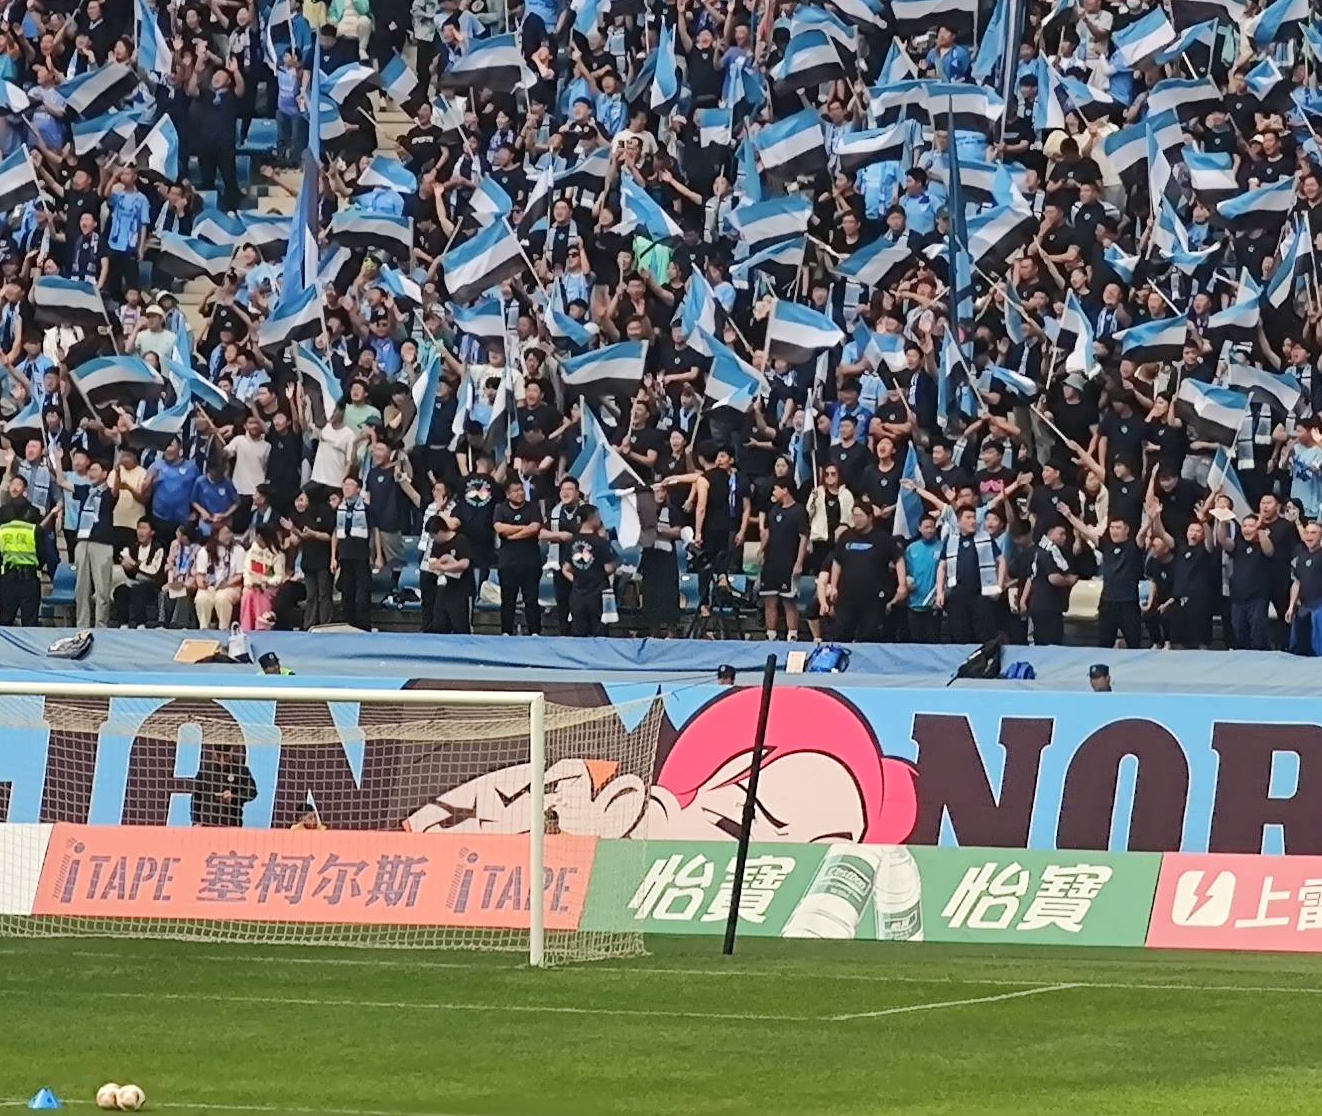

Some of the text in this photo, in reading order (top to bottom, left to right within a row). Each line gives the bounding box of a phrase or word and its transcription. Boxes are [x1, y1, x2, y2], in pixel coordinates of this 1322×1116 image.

[3, 532, 27, 545] 安保
[196, 849, 430, 908] 塞柯尔斯
[627, 853, 797, 924] 怡寶
[940, 860, 1113, 933] 怡寶
